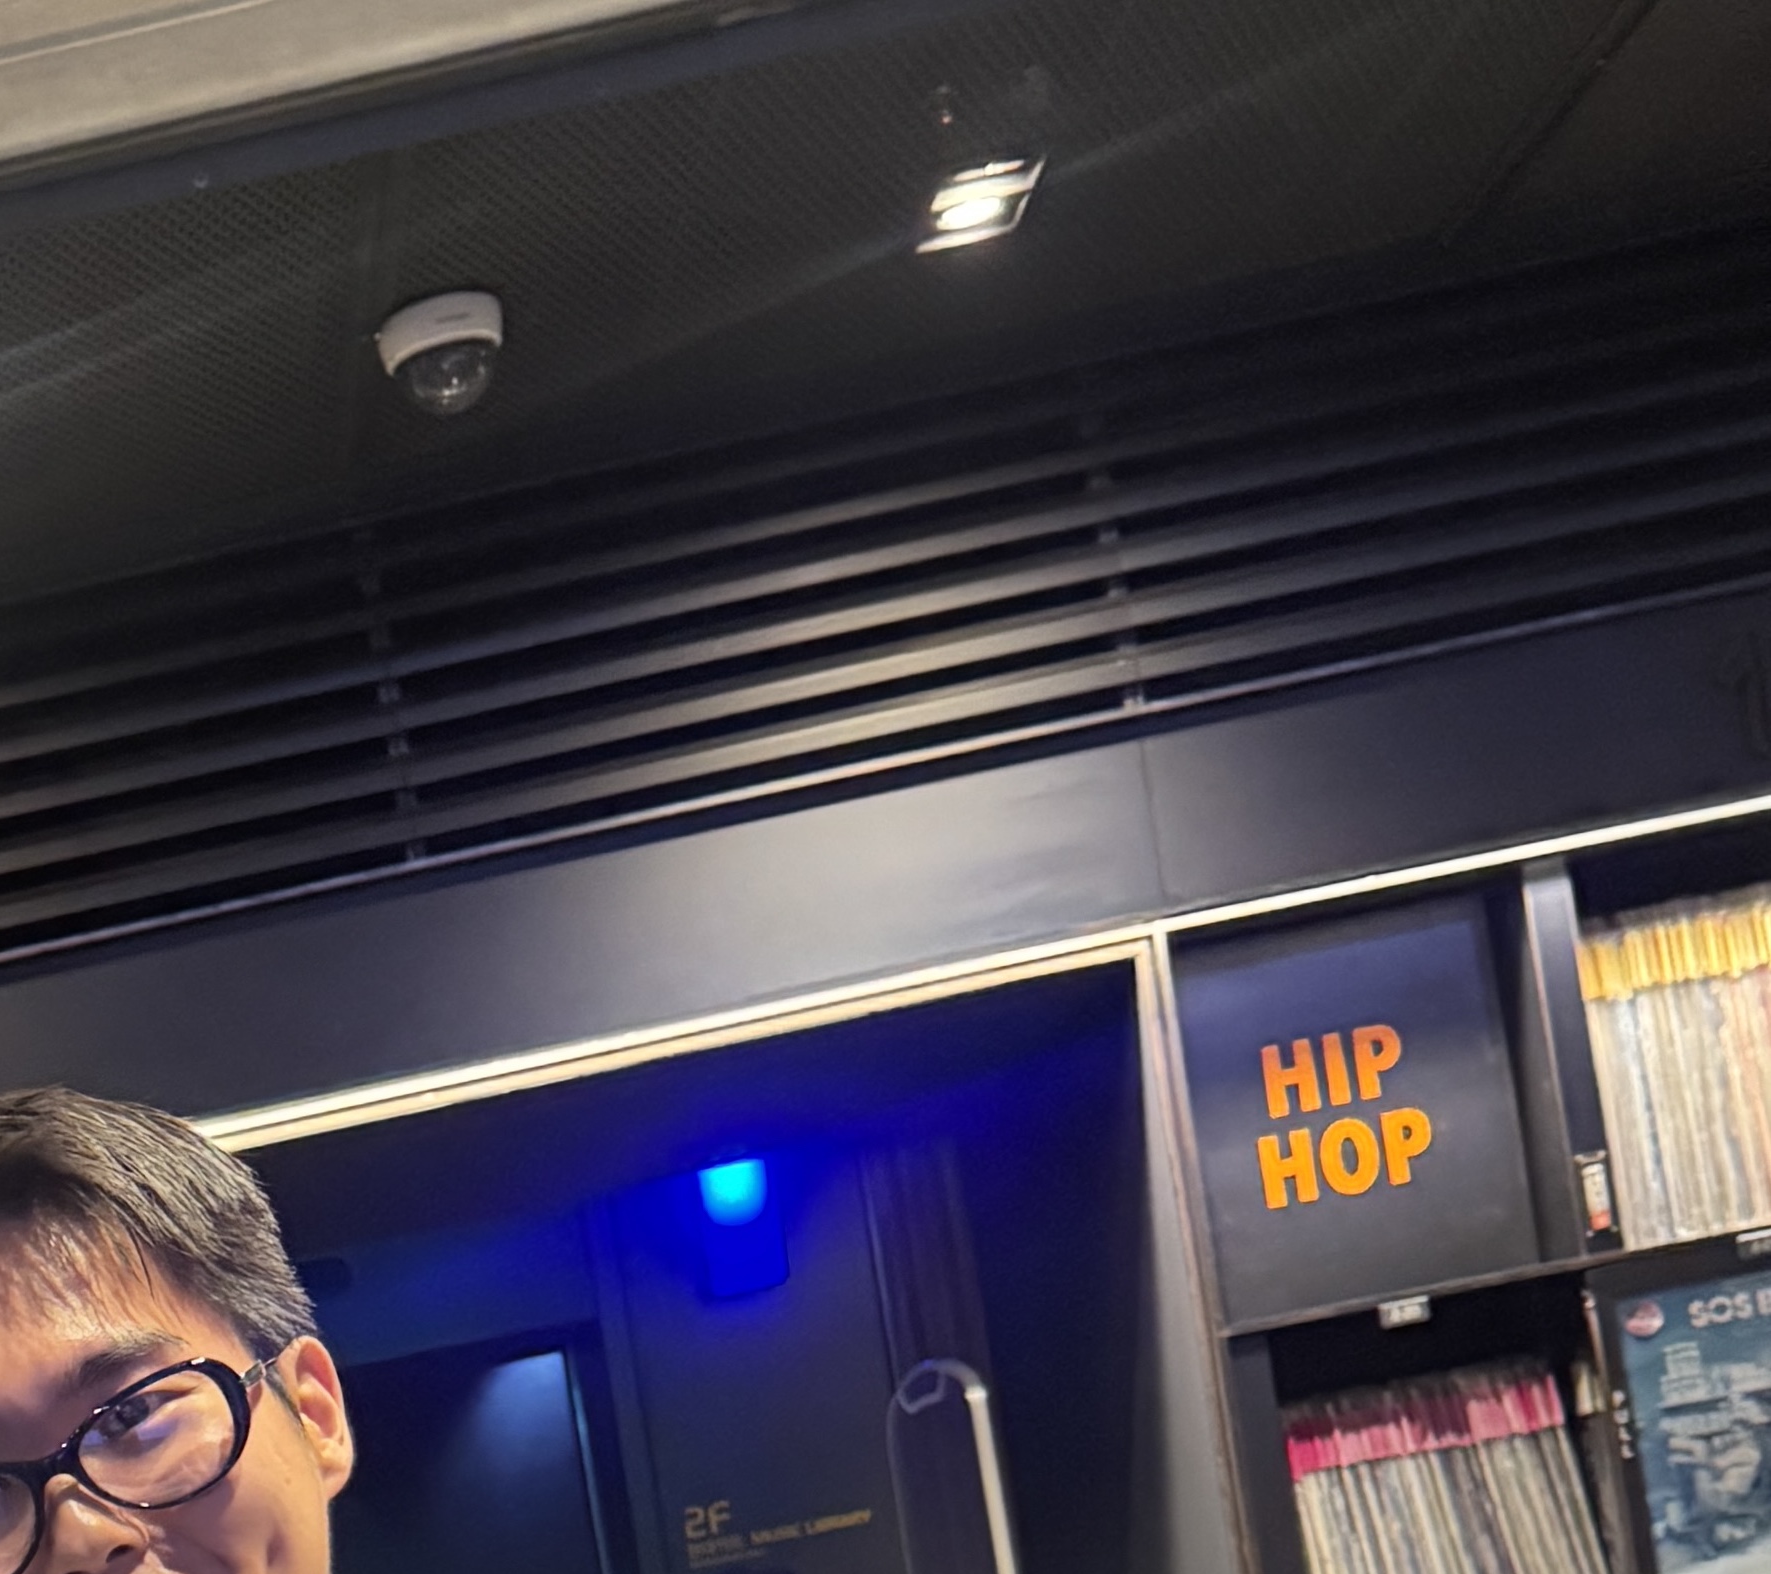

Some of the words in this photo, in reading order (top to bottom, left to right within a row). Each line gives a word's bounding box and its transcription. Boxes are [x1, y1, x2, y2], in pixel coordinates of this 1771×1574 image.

[1261, 1024, 1402, 1120] HIP
[1257, 1107, 1432, 1210] HOP
[1688, 1291, 1754, 1329] SOS
[684, 1500, 731, 1540] 2F
